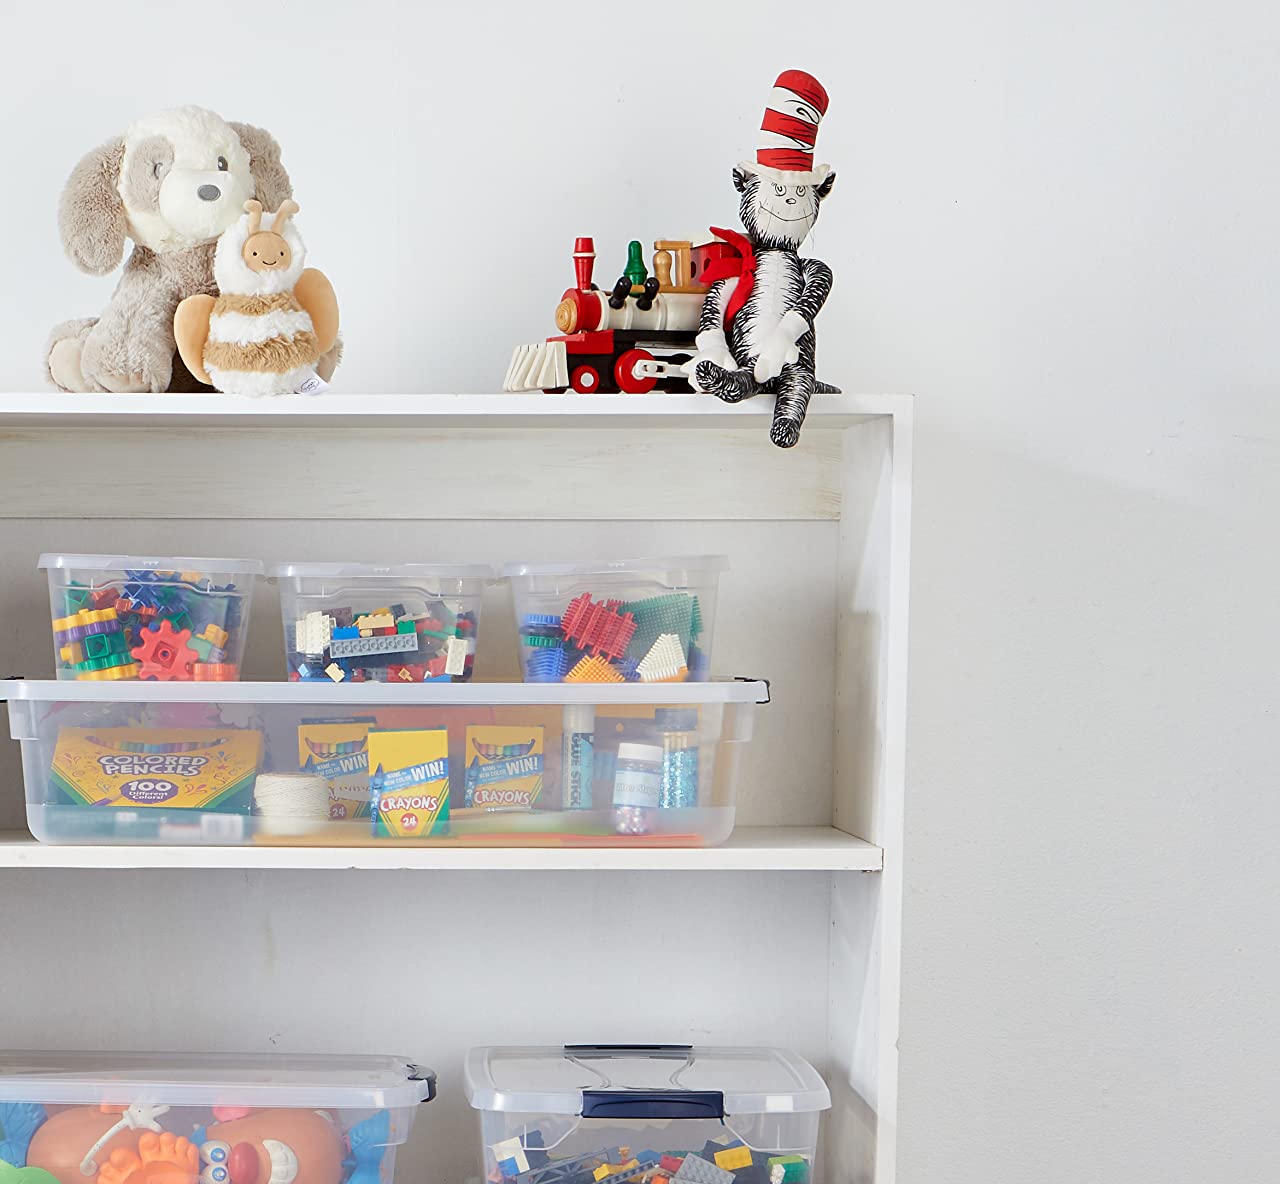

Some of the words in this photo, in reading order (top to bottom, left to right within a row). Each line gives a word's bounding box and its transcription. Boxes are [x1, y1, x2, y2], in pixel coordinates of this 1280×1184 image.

[99, 755, 208, 766] COLORED
[506, 757, 539, 776] WIN!
[104, 764, 200, 776] PENCILS
[410, 760, 445, 782] WIN!
[127, 781, 172, 791] 100
[474, 789, 531, 805] CRAYONS
[380, 796, 438, 812] CRAYONS
[332, 806, 346, 817] 24
[402, 816, 417, 827] 24
